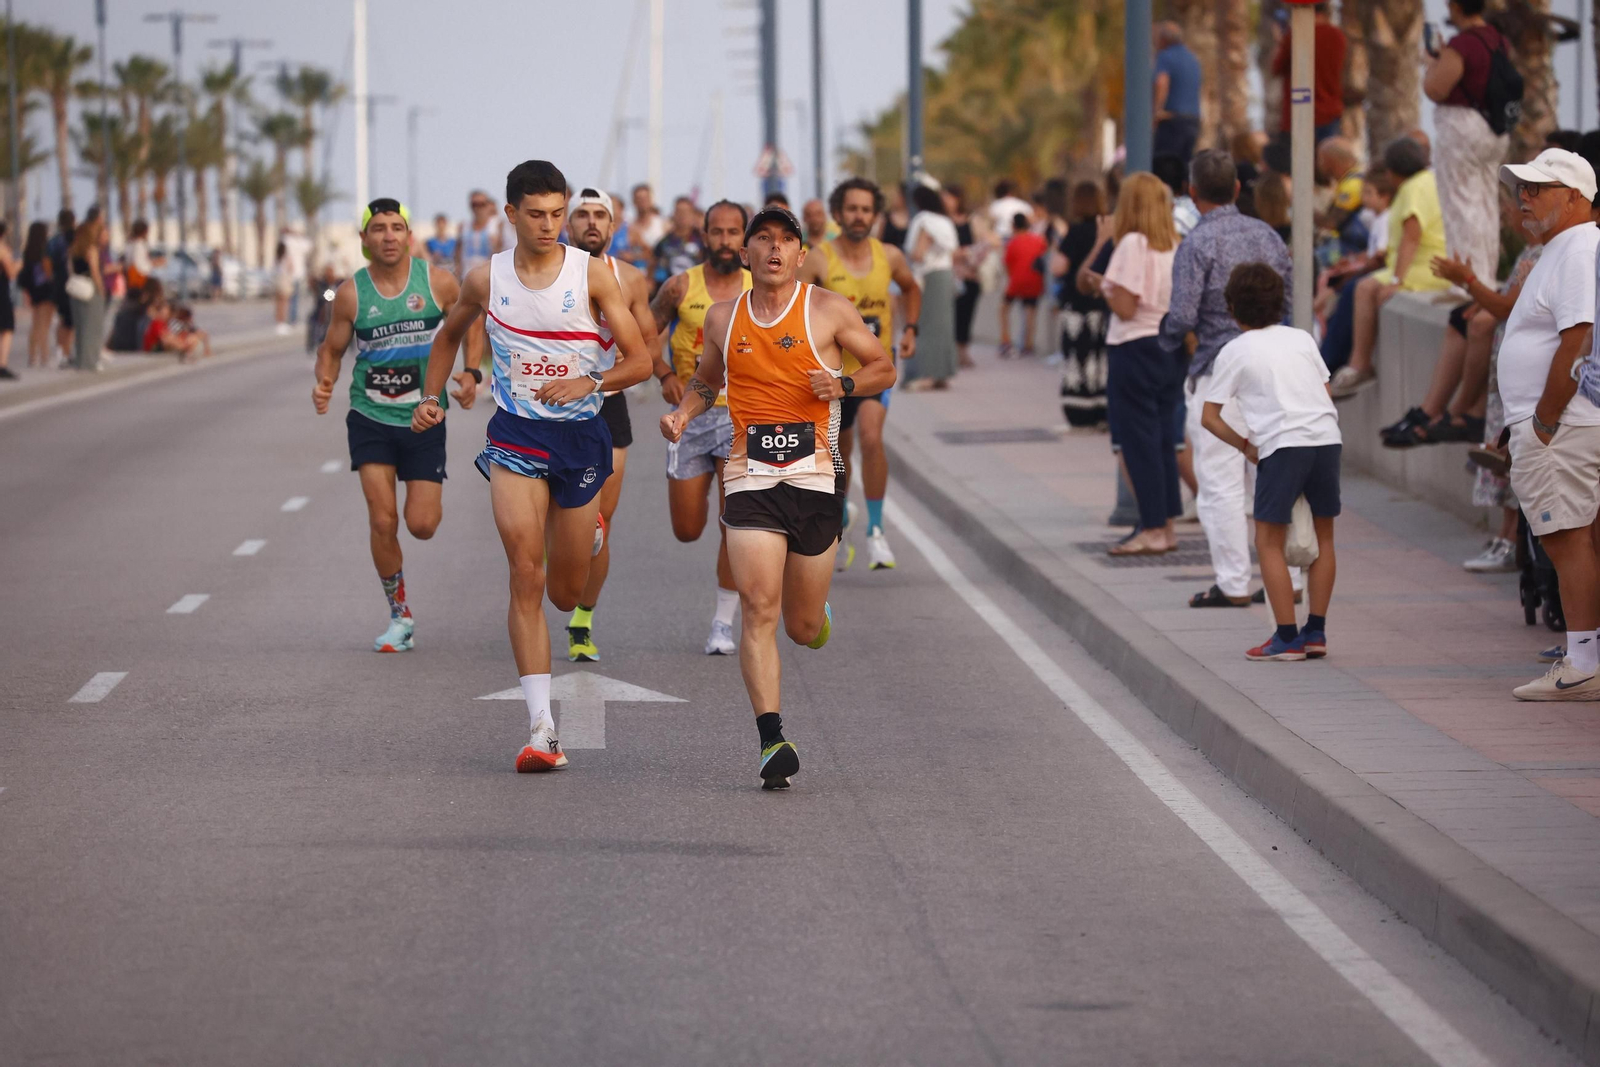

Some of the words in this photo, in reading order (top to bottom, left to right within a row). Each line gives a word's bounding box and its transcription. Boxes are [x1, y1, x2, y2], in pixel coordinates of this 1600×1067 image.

[372, 320, 425, 339] ATLETISMO
[521, 362, 569, 377] 3269
[371, 374, 412, 385] 2340
[761, 434, 799, 449] 805
